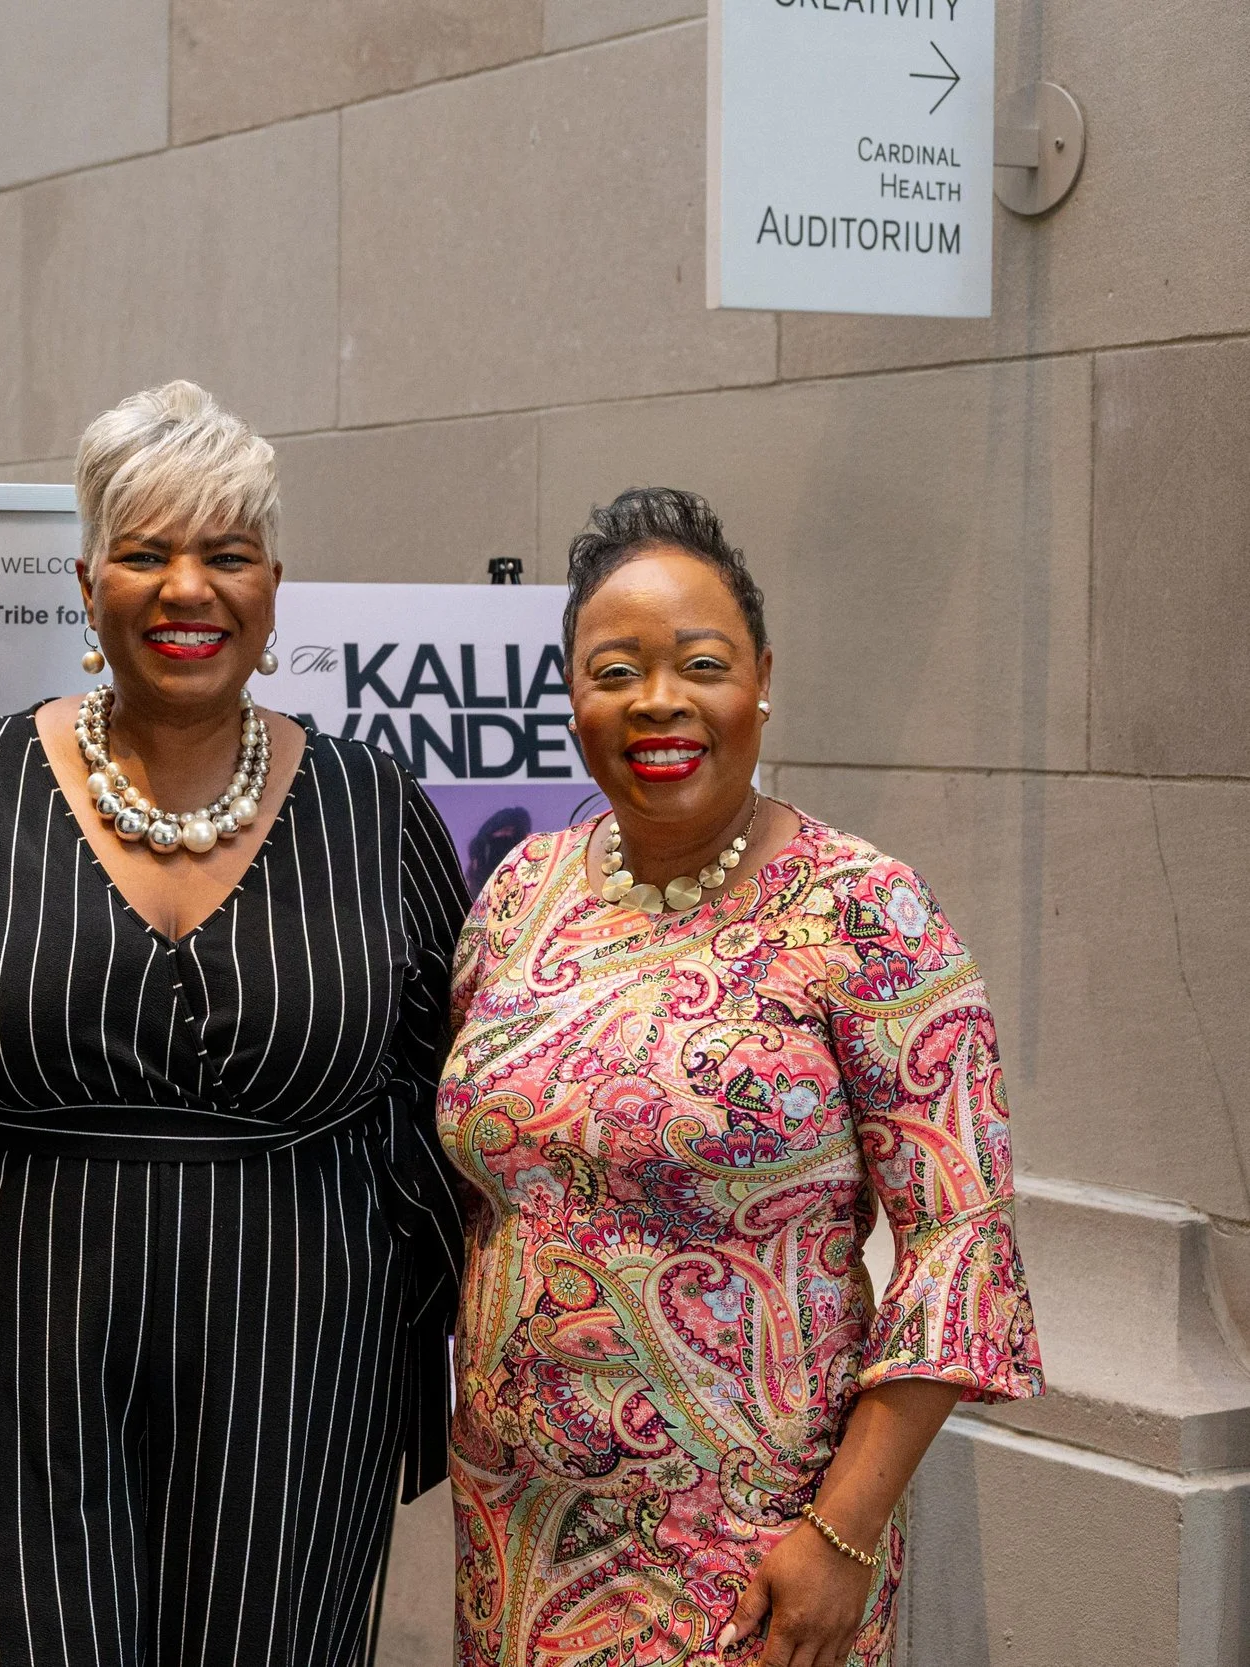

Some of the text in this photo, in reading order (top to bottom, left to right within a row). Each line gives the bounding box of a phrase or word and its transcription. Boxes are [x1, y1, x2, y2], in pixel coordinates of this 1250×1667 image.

[56, 606, 87, 625] for
[290, 642, 572, 710] The KALIA
[296, 712, 594, 779] ANDE
